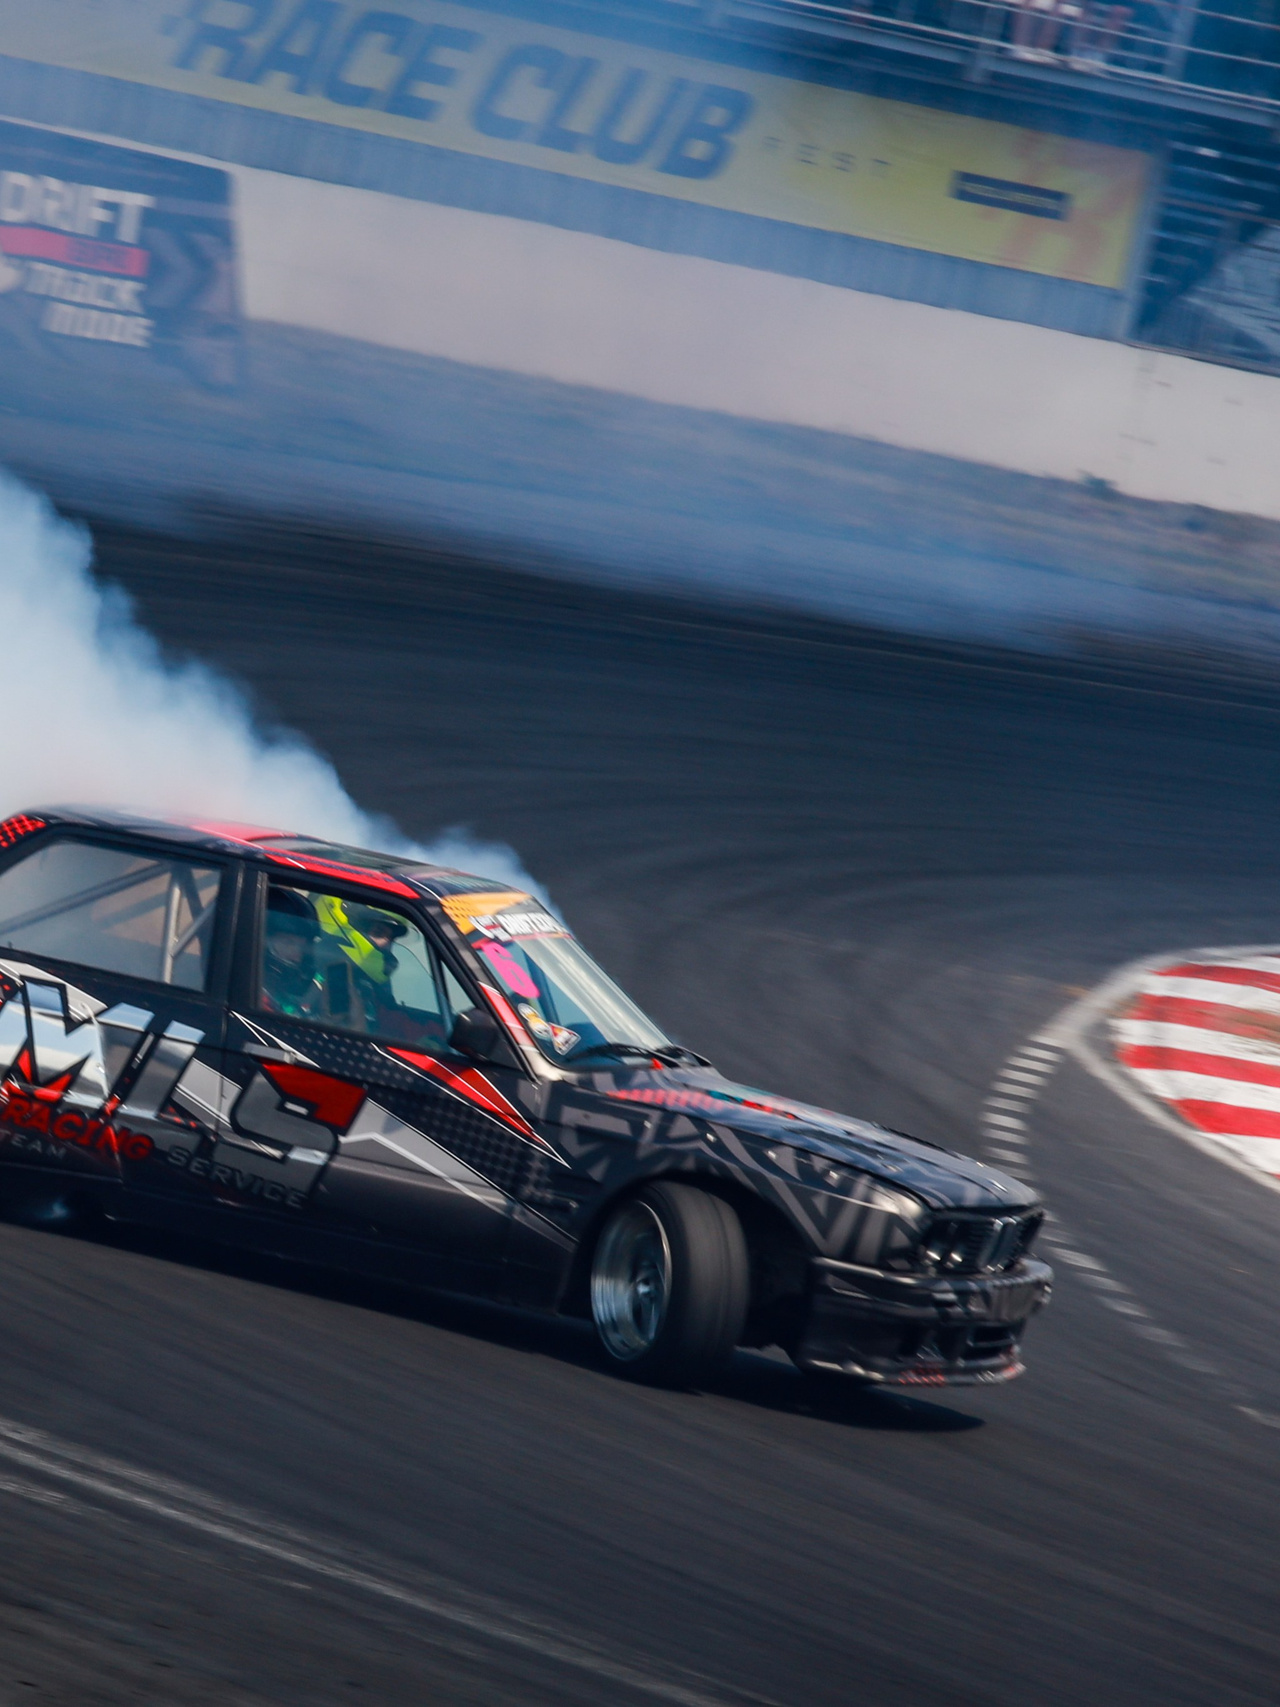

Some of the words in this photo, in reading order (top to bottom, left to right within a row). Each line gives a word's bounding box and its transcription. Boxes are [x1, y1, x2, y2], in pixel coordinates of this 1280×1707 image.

[172, 0, 483, 122] RACE
[469, 42, 754, 180] CLUB
[0, 1096, 156, 1162] RACING
[167, 1145, 309, 1209] SERVICE
